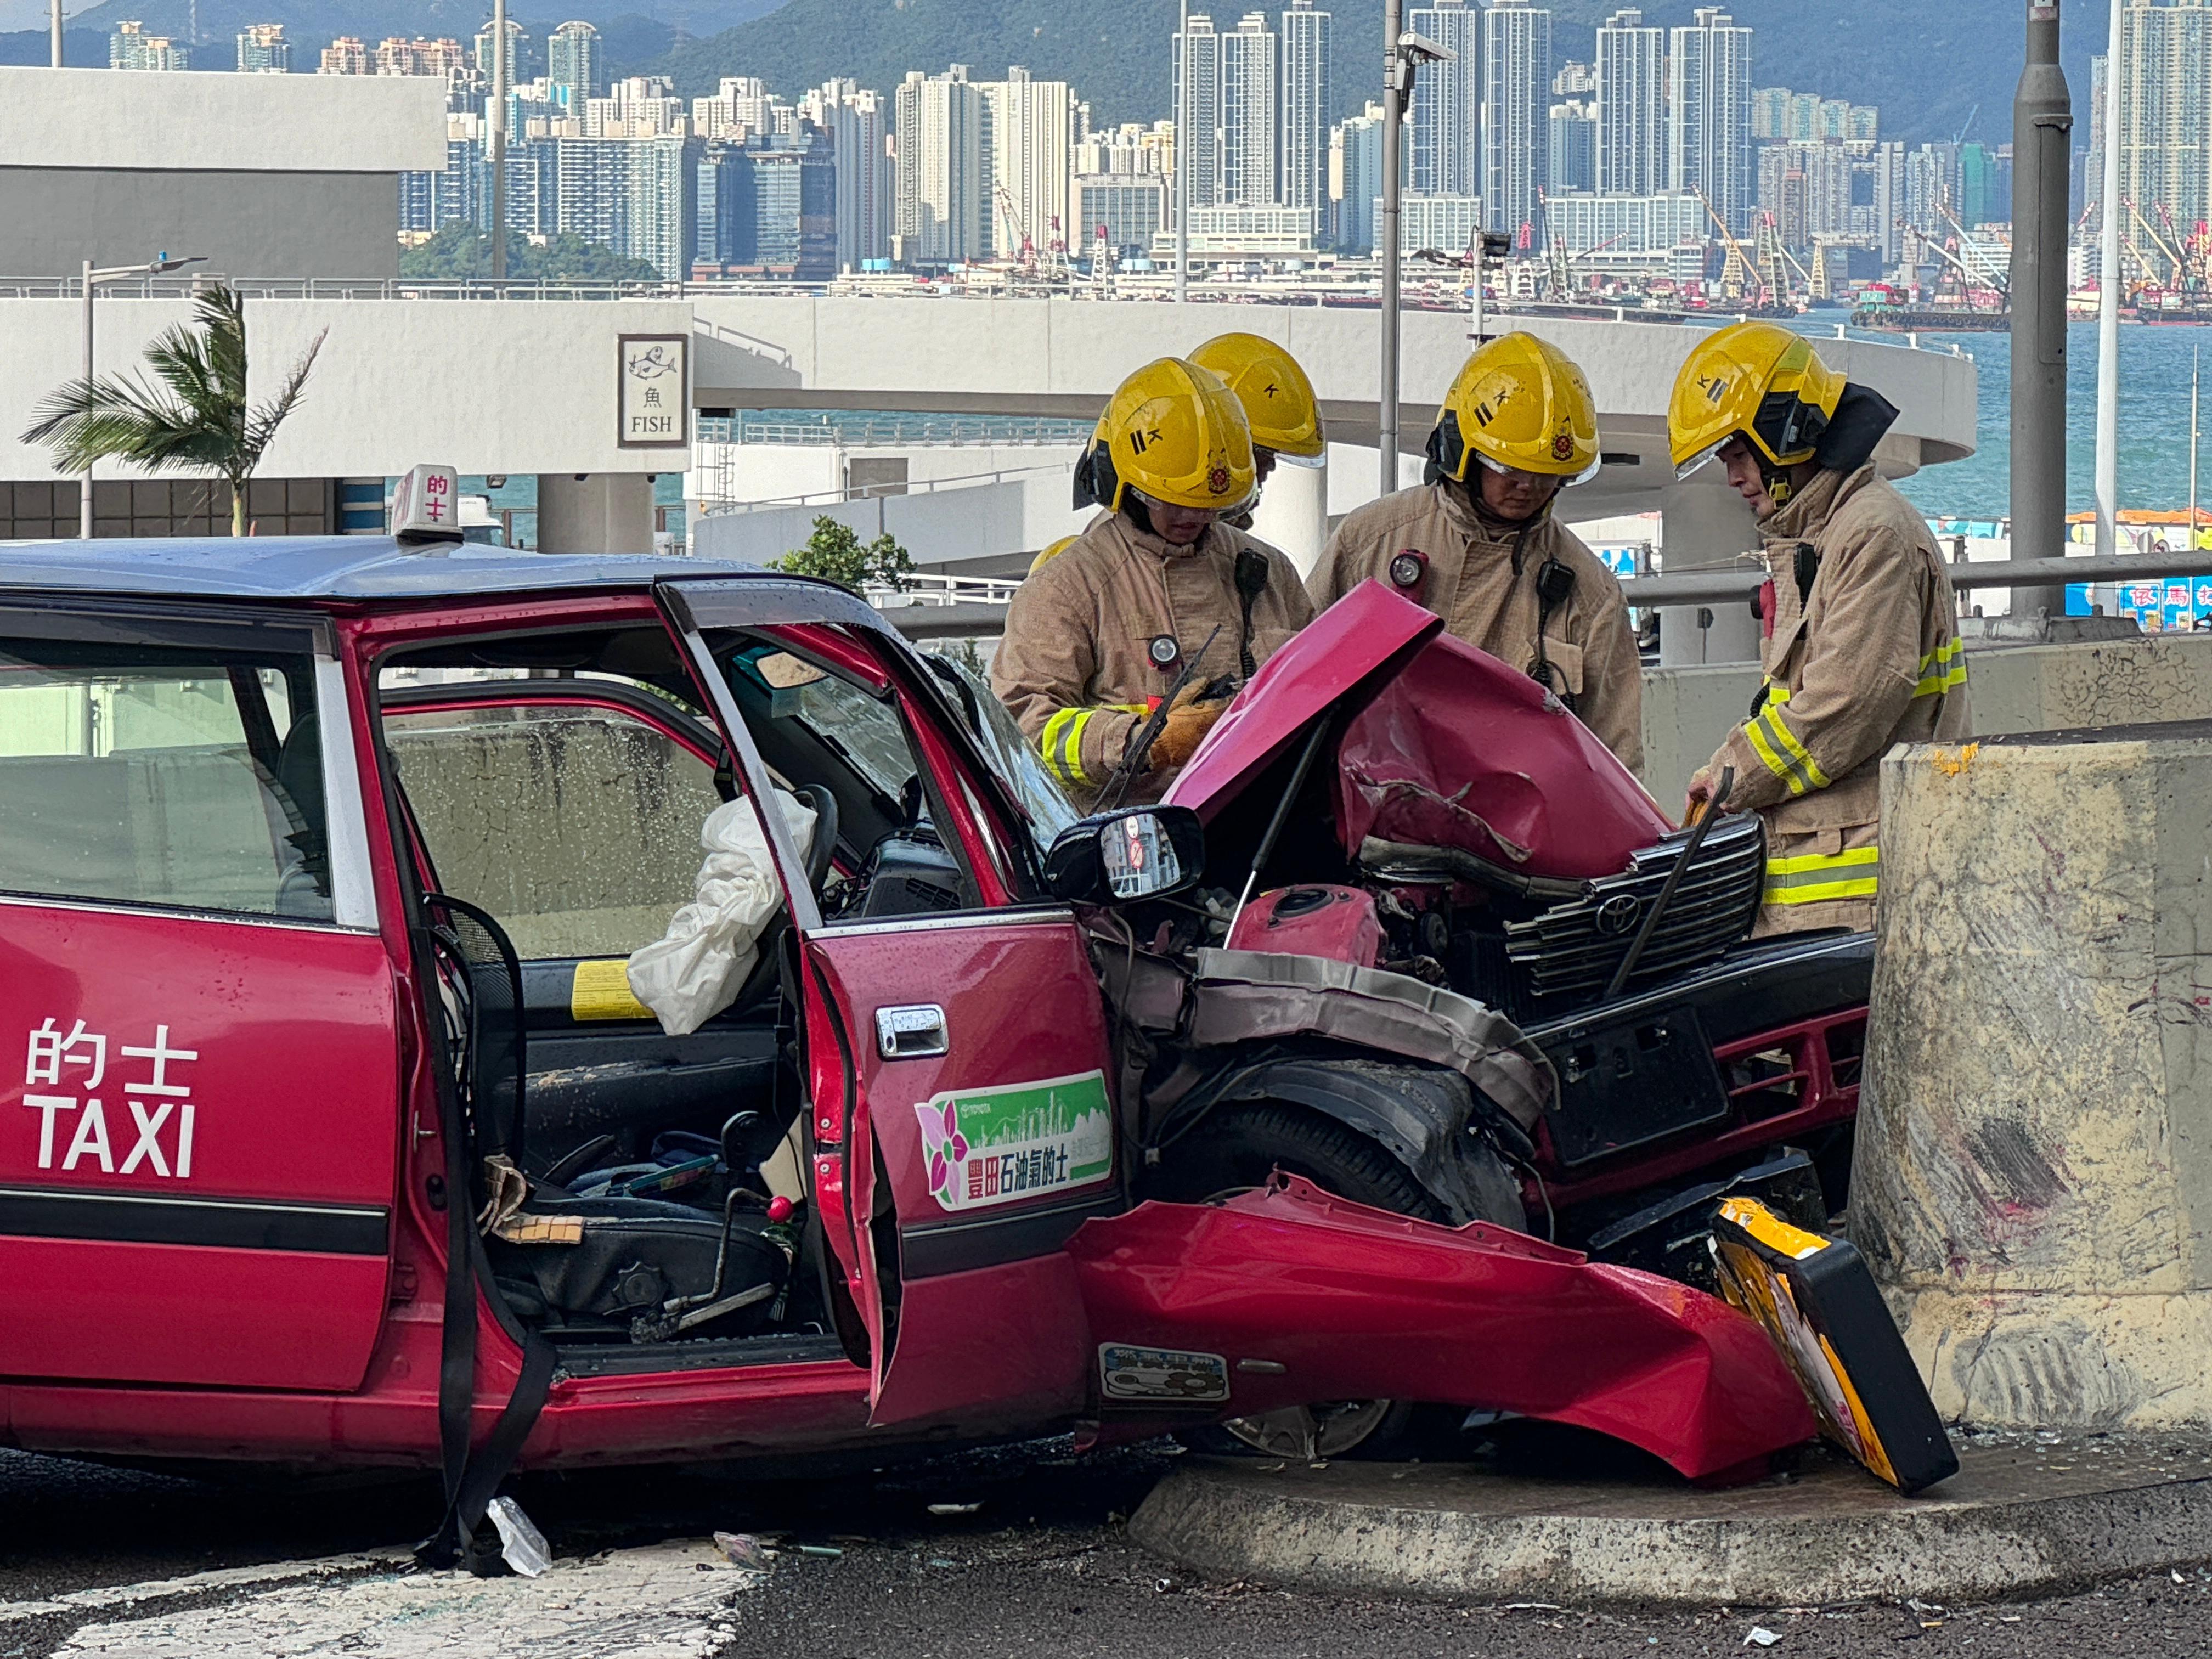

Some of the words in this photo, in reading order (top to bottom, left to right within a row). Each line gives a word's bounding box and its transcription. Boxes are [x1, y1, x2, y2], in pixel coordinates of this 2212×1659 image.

[1697, 374, 1711, 388] K
[643, 386, 662, 408] 魚
[1264, 383, 1279, 399] K
[1493, 390, 1510, 407] K
[631, 416, 672, 432] FISH
[1147, 428, 1163, 445] K
[425, 475, 448, 517] 的士
[26, 1017, 198, 1097] 的士
[22, 1094, 195, 1178] TAXI
[968, 1143, 1068, 1200] 豐田石油氣的士
